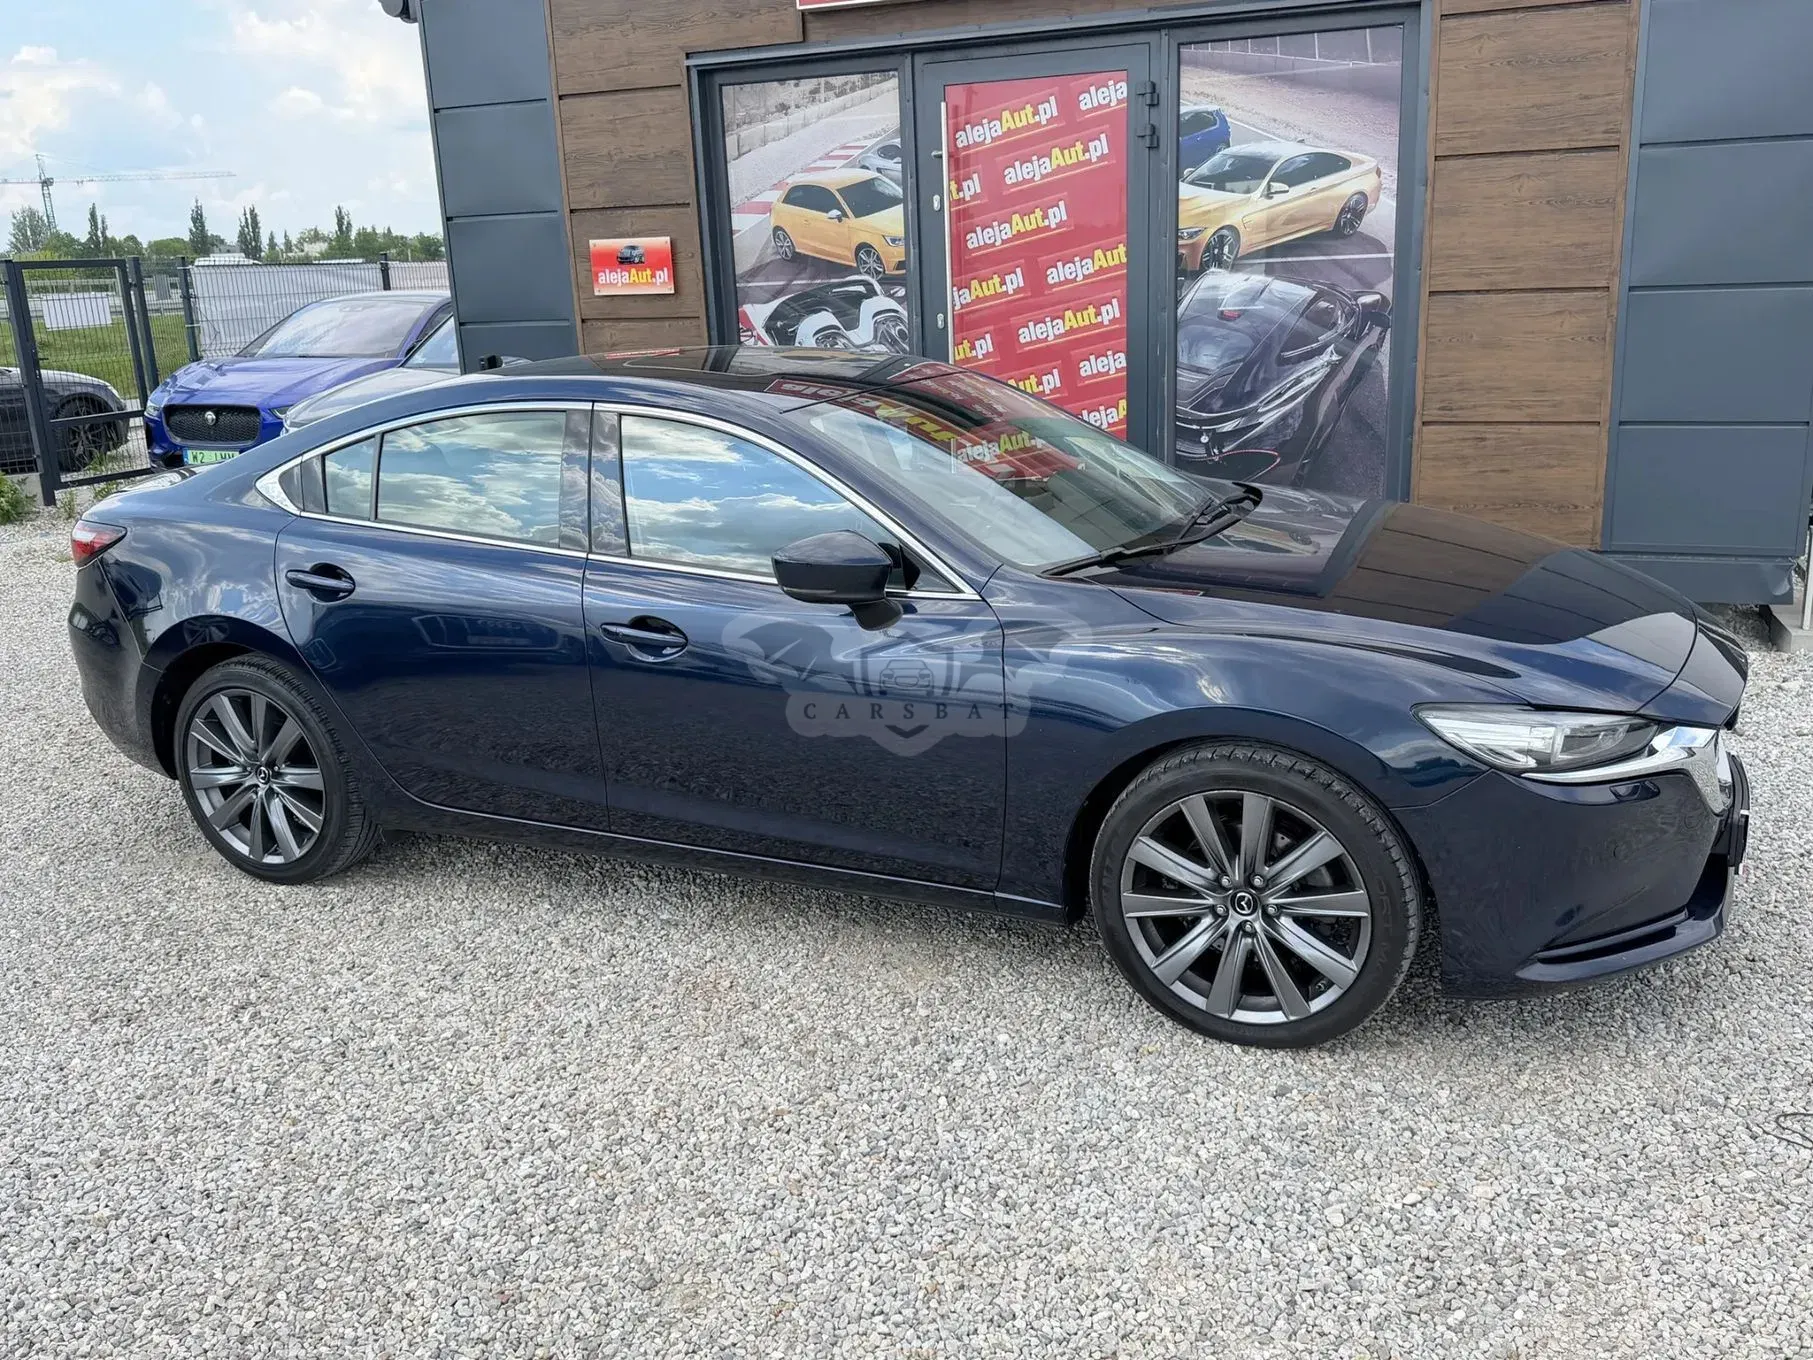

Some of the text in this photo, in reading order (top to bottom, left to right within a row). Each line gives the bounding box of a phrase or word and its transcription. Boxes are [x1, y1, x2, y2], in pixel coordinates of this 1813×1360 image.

[955, 96, 1059, 148] alejaAut.pl
[1004, 133, 1109, 185] alejaAut.pl
[966, 200, 1067, 249] alejaAut.pl
[598, 267, 669, 287] alejaAut.pl
[1046, 244, 1127, 284] alejaAut
[1018, 298, 1120, 344] alejaAut.pl
